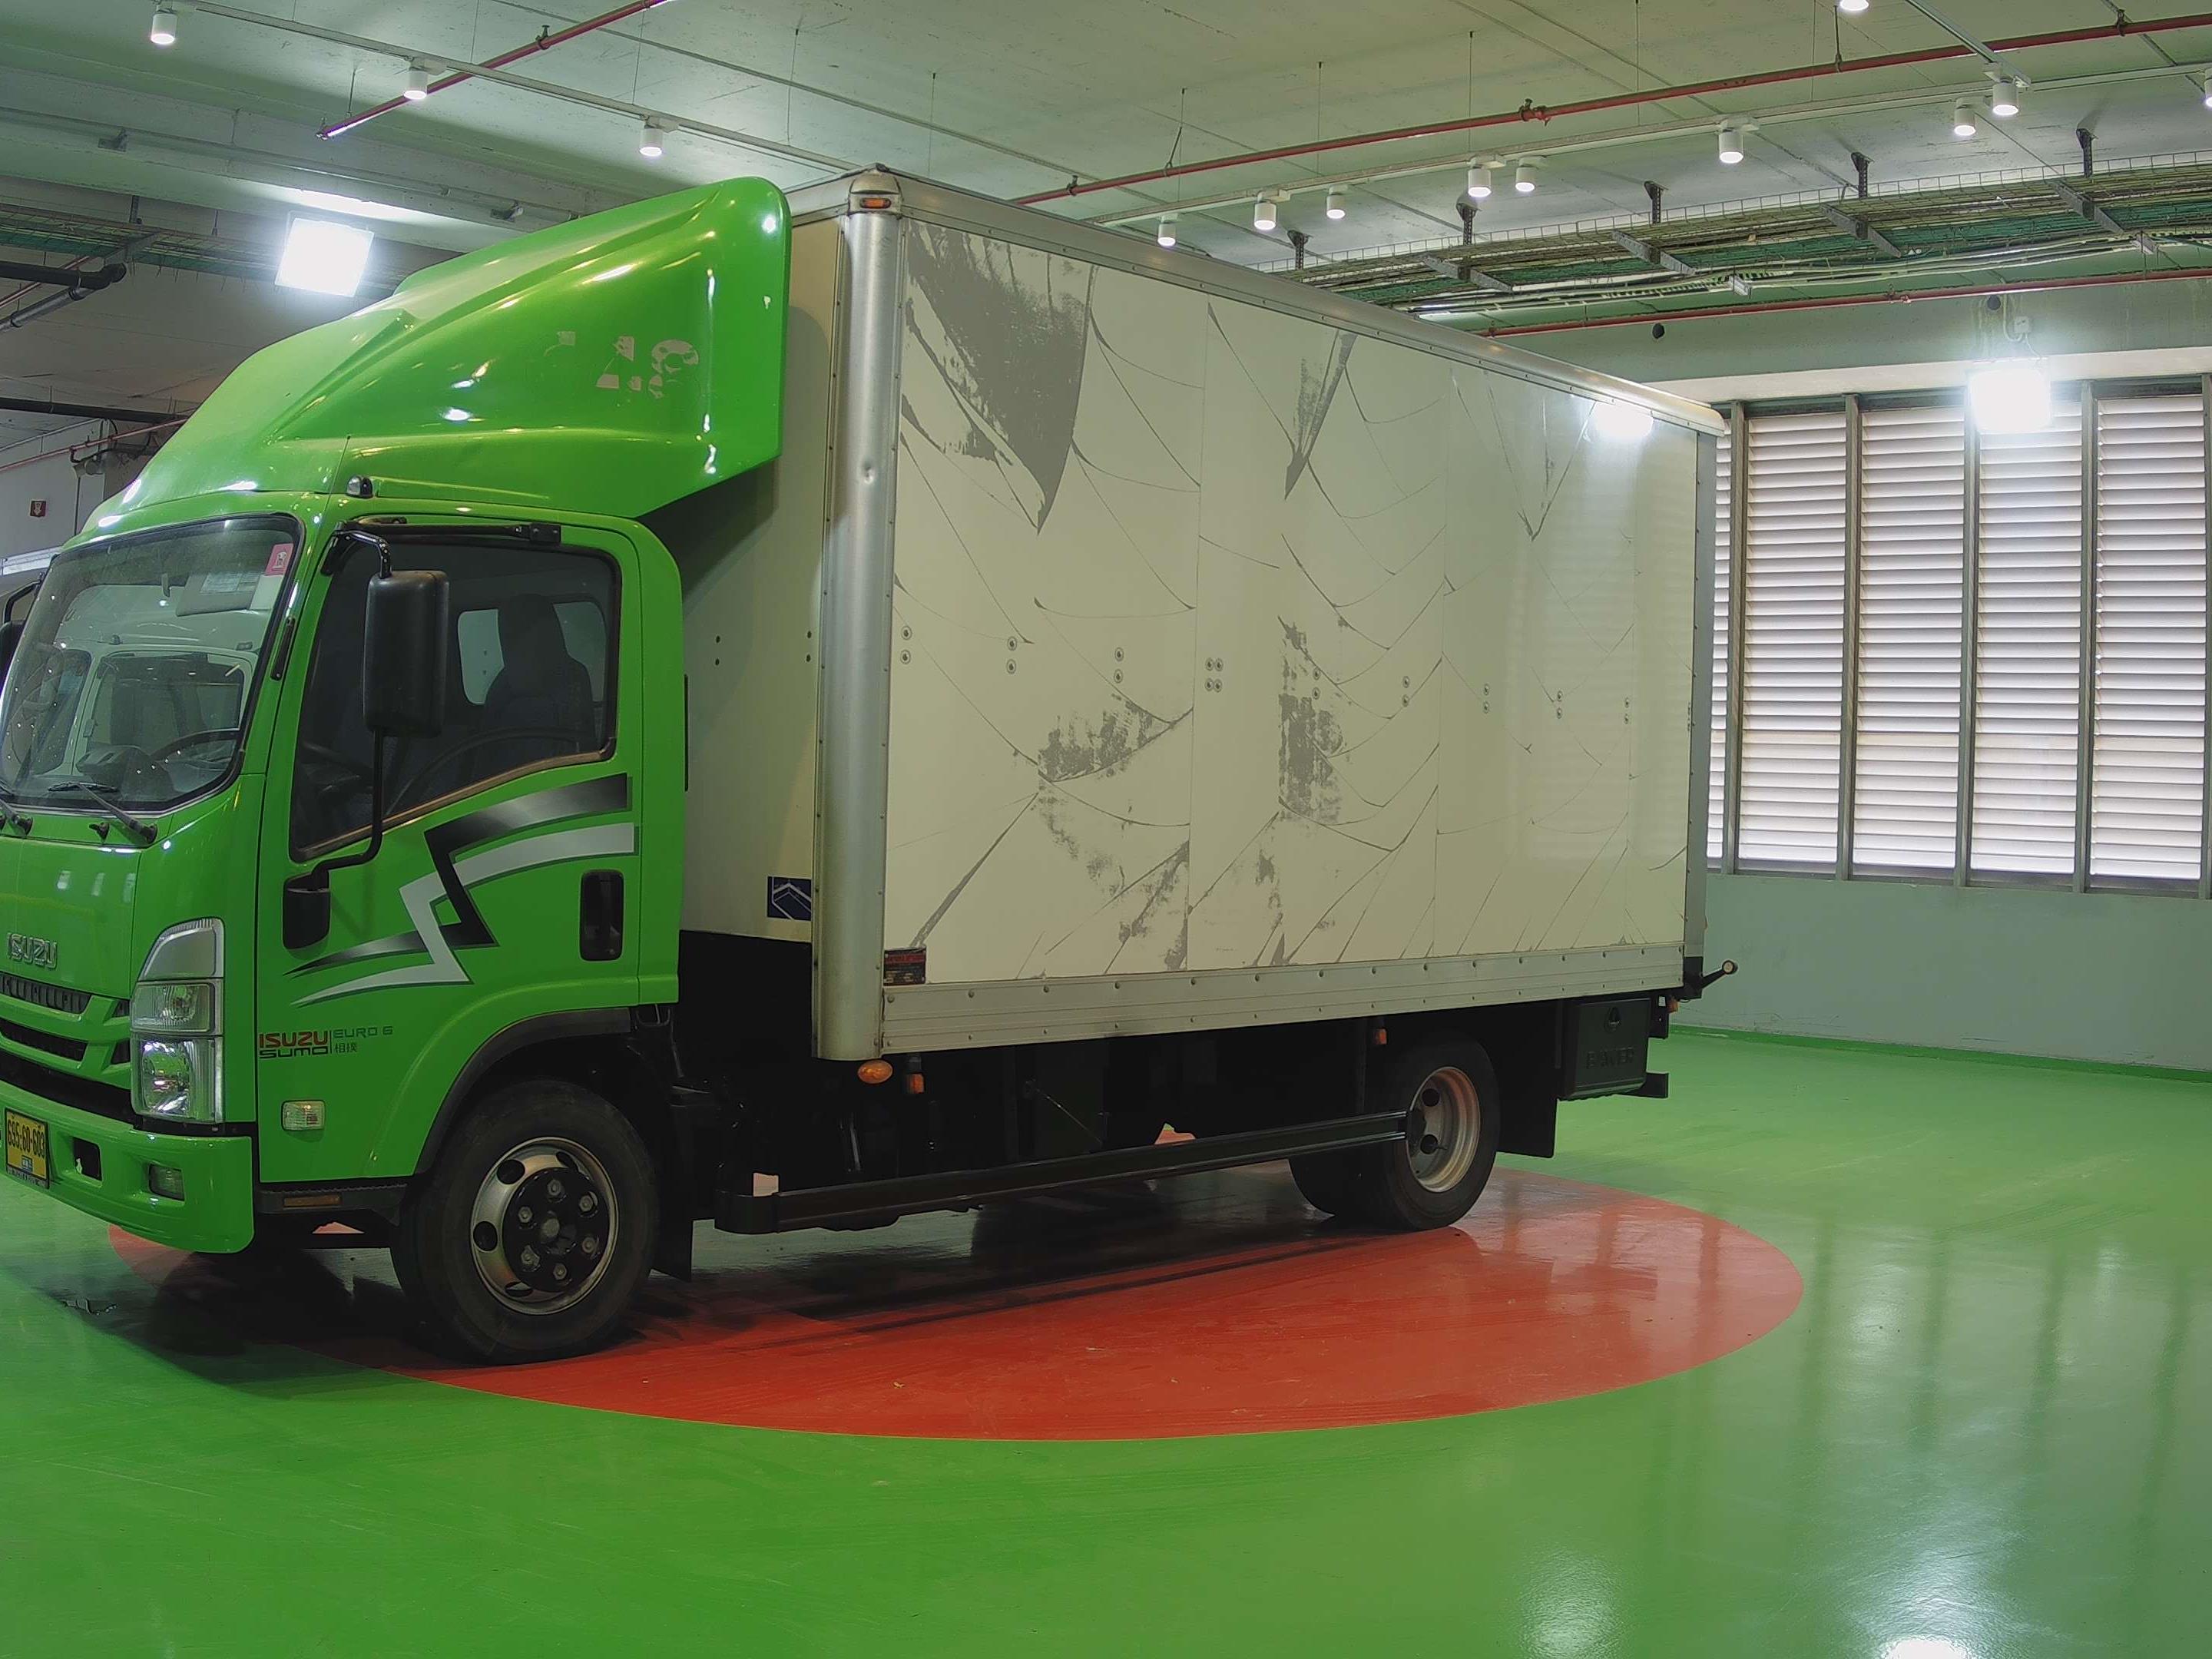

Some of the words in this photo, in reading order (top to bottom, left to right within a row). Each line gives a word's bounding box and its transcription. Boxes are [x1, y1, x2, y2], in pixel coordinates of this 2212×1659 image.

[7, 932, 58, 969] ISUZU
[259, 1031, 329, 1048] ISUZU
[333, 1027, 378, 1038] EURO
